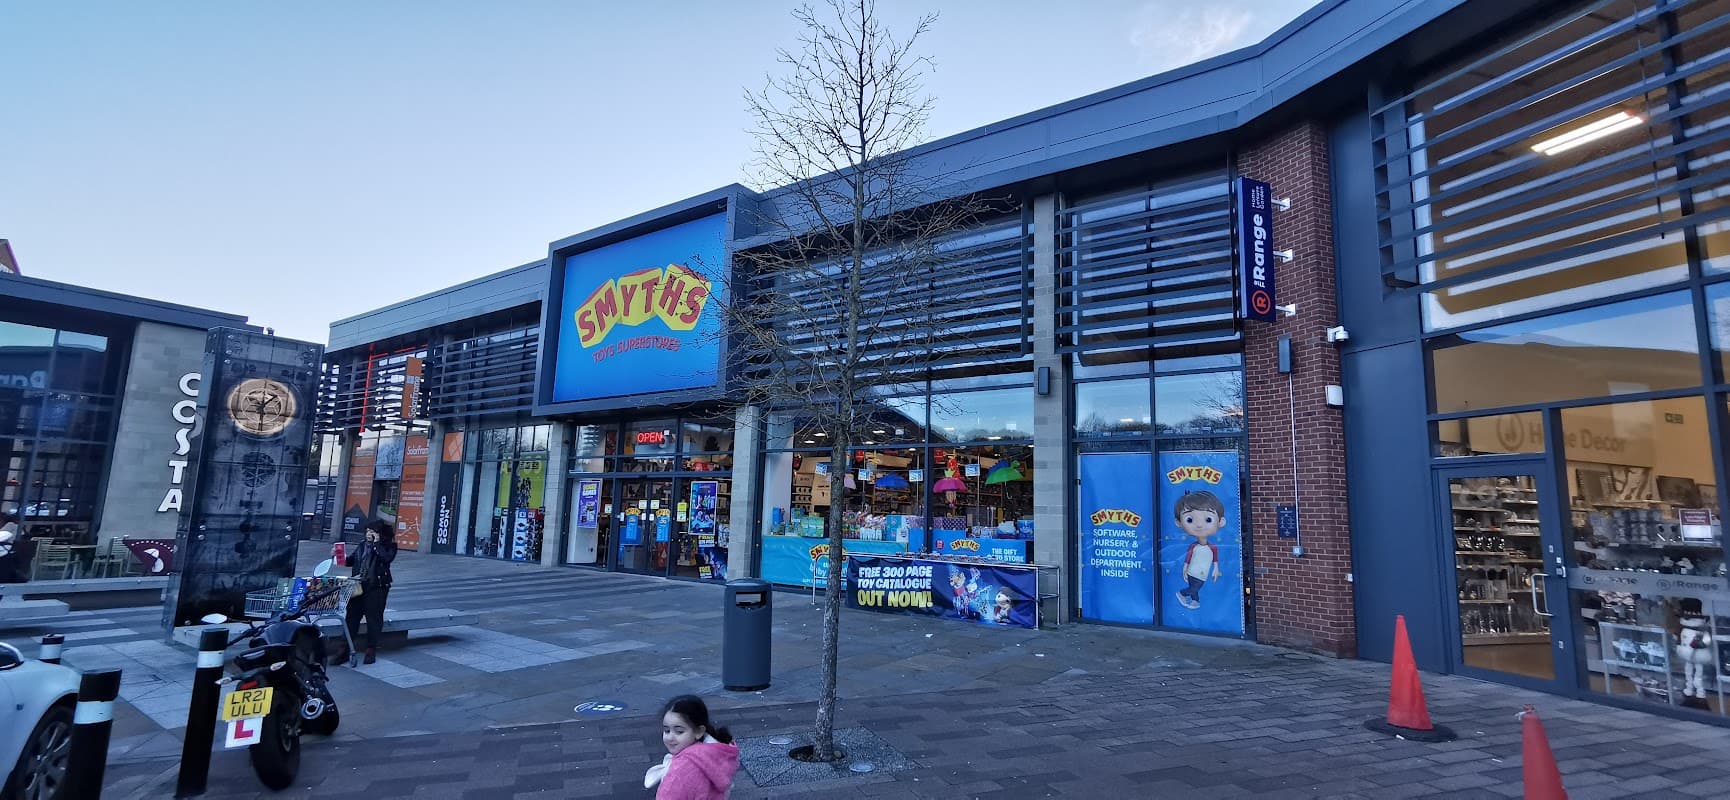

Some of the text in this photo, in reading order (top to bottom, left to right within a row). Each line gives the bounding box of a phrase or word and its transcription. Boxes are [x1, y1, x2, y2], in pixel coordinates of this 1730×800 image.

[1253, 214, 1266, 280] Range
[577, 274, 707, 343] SMYTHS
[592, 335, 681, 362] TOYS SUPERSTORES
[157, 372, 202, 513] COSTA
[637, 432, 663, 443] OPEN
[1581, 429, 1627, 452] Decor
[1168, 467, 1221, 483] SMYTHS
[437, 496, 447, 544] COMING
[1091, 510, 1140, 526] SMYTHS
[441, 509, 450, 545] SOON
[1093, 528, 1138, 539] SOFTWARE,
[951, 539, 979, 550] SMYTHS
[1093, 539, 1138, 548] NURSERY &
[991, 547, 1017, 556] THE GIFT
[1094, 548, 1137, 558] OUTDOOR
[1090, 558, 1142, 568] DEPARTMENT
[858, 566, 881, 578] FREE
[882, 566, 904, 578] 300
[905, 565, 933, 577] PAGE
[1100, 569, 1129, 578] INSIDE
[857, 578, 875, 589] TOY
[875, 578, 932, 589] CATALOGUE
[857, 590, 933, 608] OUT NOW!
[231, 690, 266, 704] LR21
[231, 702, 262, 717] ULU
[234, 719, 253, 739] L
